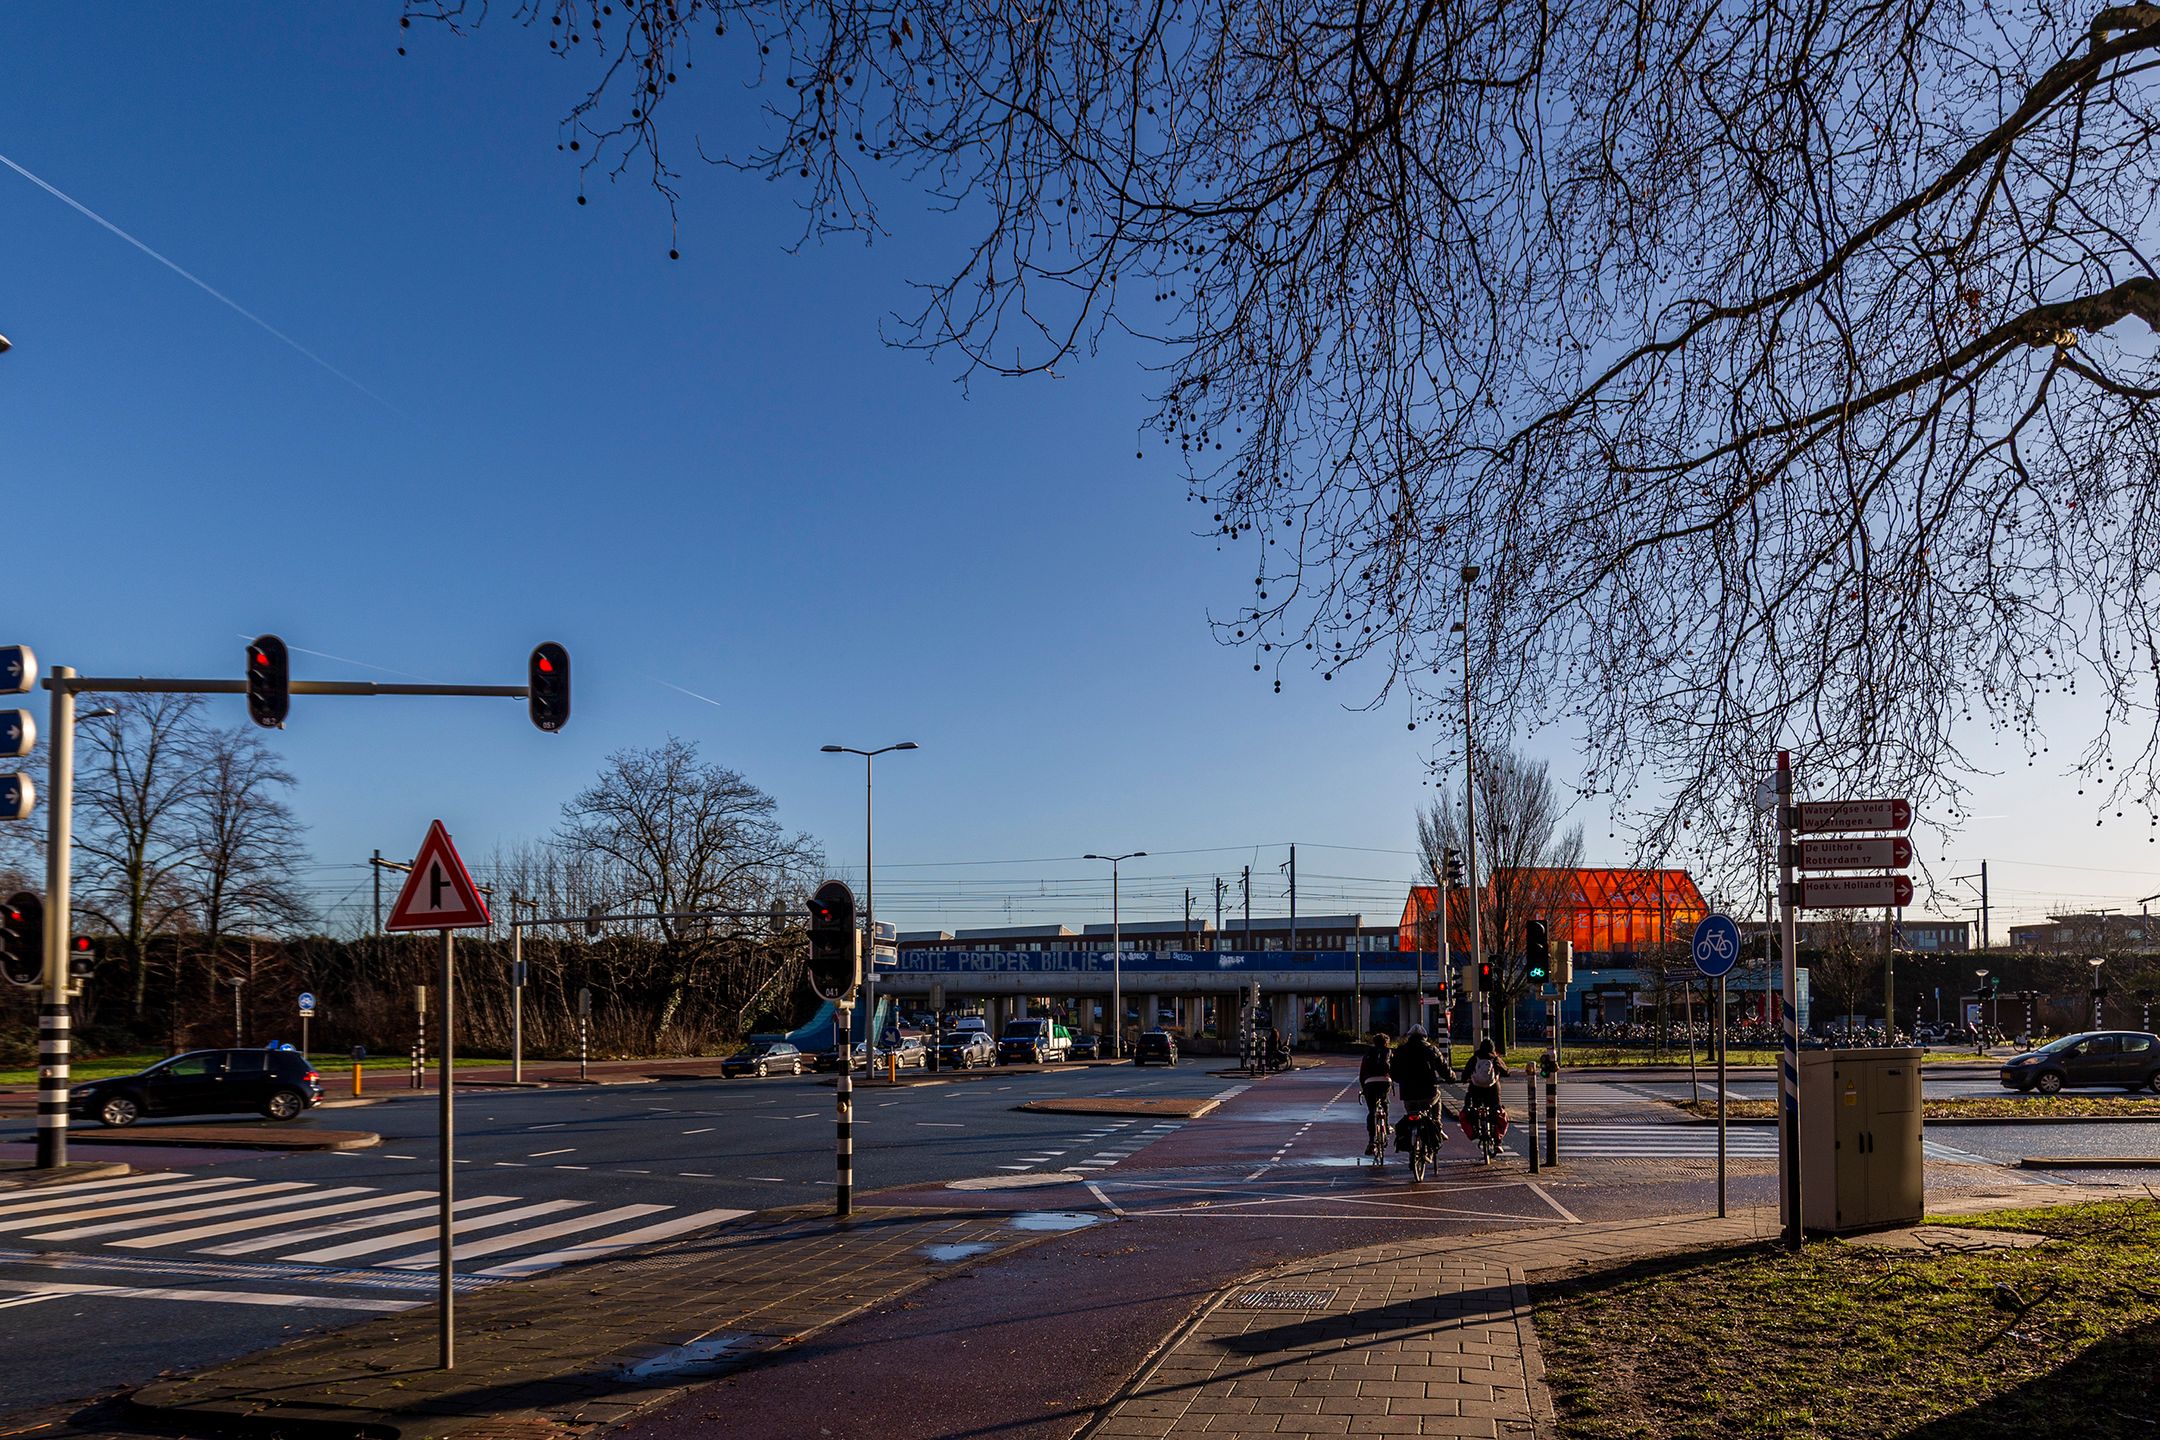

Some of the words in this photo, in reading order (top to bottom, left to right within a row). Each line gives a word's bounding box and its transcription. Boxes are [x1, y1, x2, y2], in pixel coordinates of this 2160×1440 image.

[1804, 805, 1859, 815] Wateringse
[1863, 804, 1883, 812] Veld
[1804, 818, 1863, 827] Wateringen
[1805, 844, 1818, 852] De
[1821, 843, 1853, 852] Uithof
[1805, 856, 1859, 865] Rotterdam
[1862, 856, 1872, 864] 17
[1806, 882, 1832, 890] Hoek
[1844, 881, 1881, 889] Holland
[1611, 891, 1684, 904] HAAG
[957, 951, 1034, 971] PROPER.
[825, 987, 839, 997] 04.1
